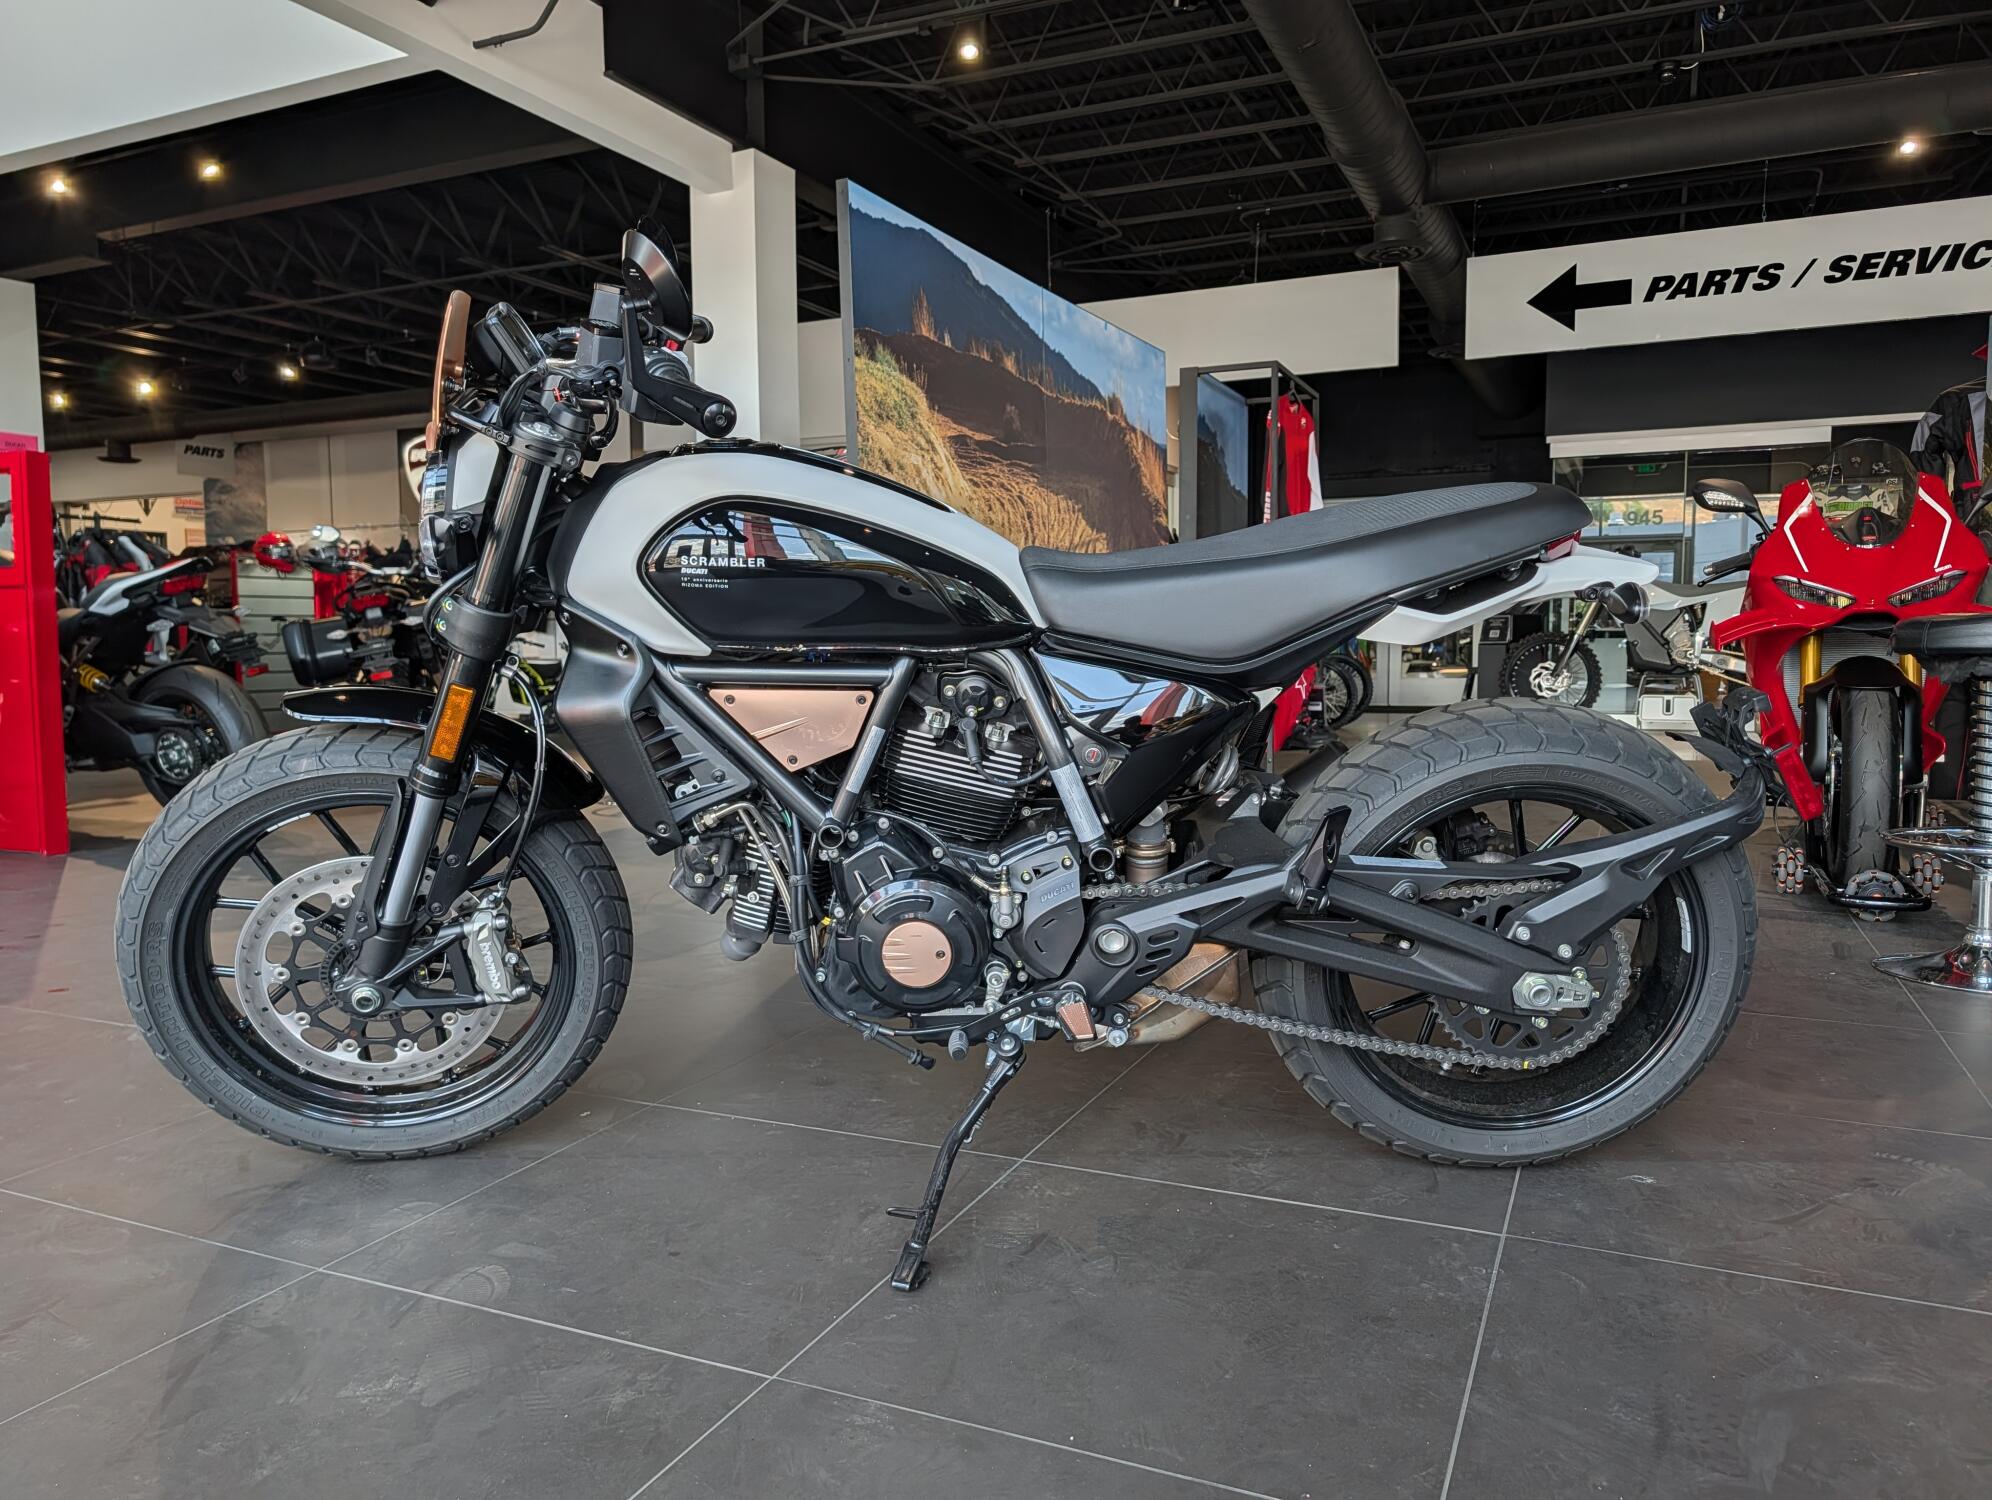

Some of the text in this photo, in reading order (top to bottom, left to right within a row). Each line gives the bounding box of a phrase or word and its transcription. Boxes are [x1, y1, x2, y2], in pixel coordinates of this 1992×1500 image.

[1642, 262, 1785, 303] PARTS
[1790, 258, 1818, 289] /
[183, 444, 225, 459] PARTS
[1625, 509, 1664, 526] 945
[680, 555, 766, 568] SCRAMBLER
[680, 567, 708, 575] DUCATI
[1040, 881, 1074, 903] DUCATI
[478, 942, 502, 990] brembo
